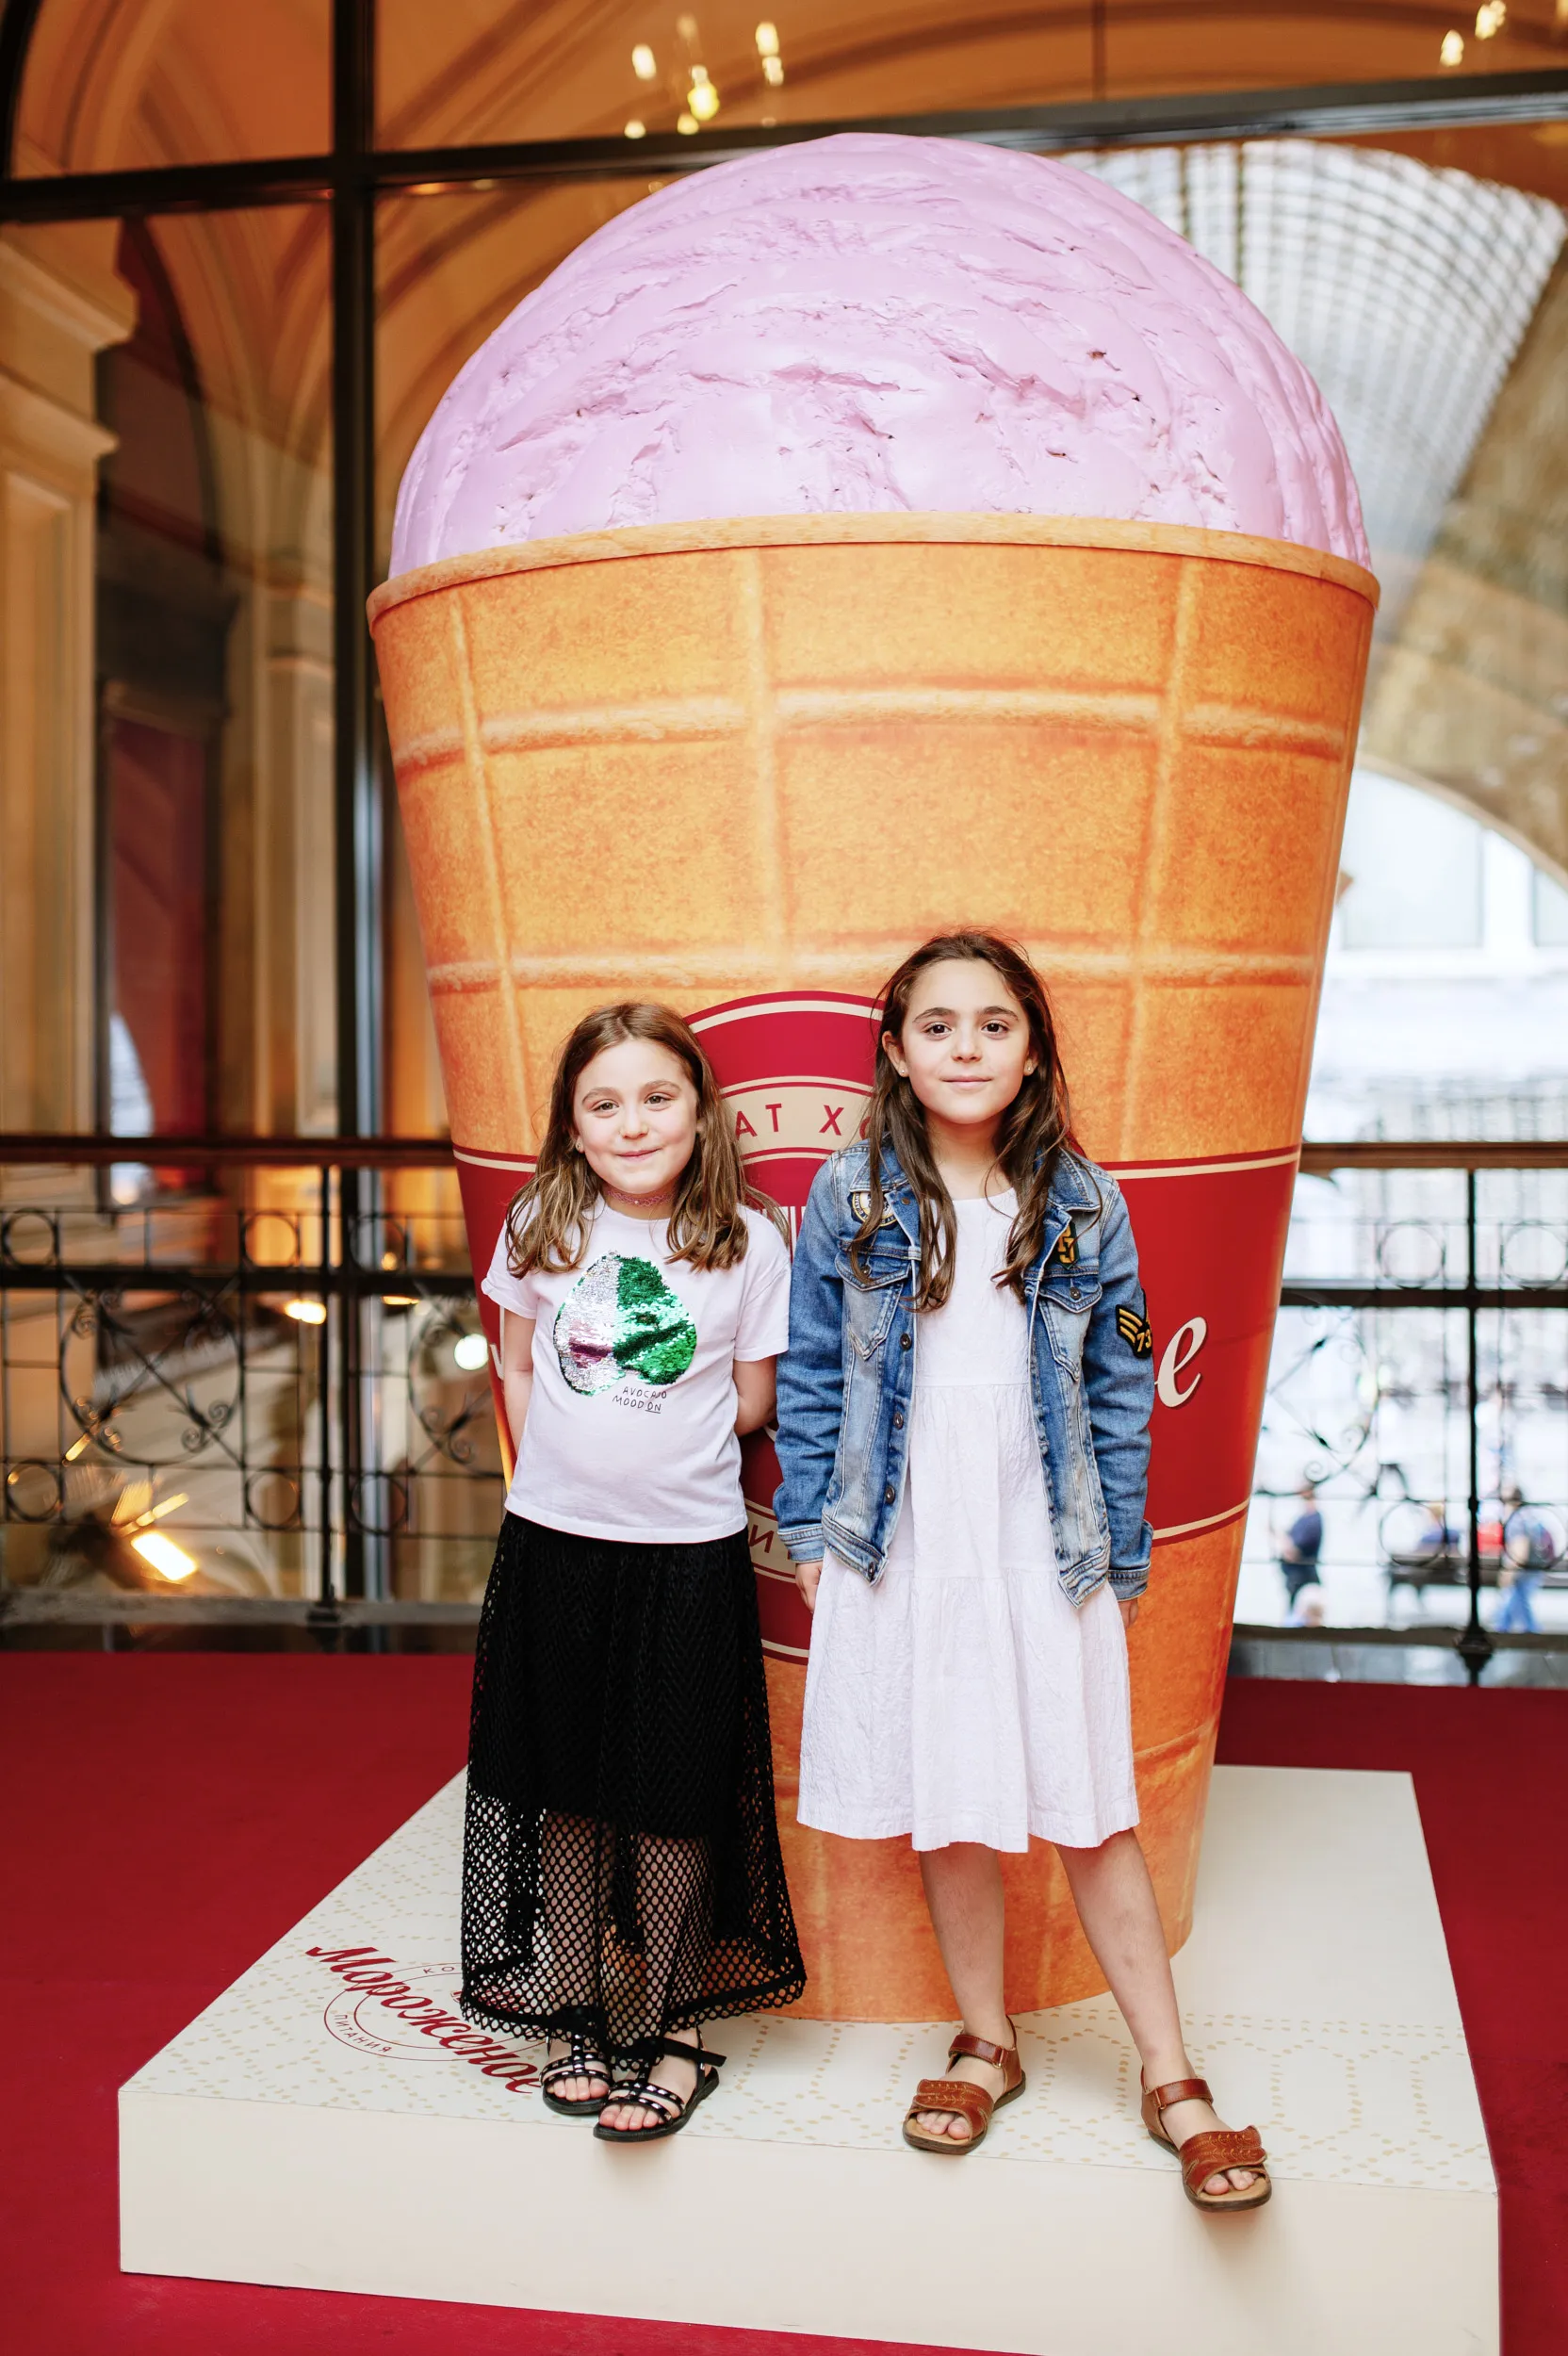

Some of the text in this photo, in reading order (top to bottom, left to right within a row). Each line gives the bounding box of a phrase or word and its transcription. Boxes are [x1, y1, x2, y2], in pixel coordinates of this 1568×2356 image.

[612, 1395, 662, 1414] MOOD ON
[334, 2014, 392, 2053] ПИТАНИЯ
